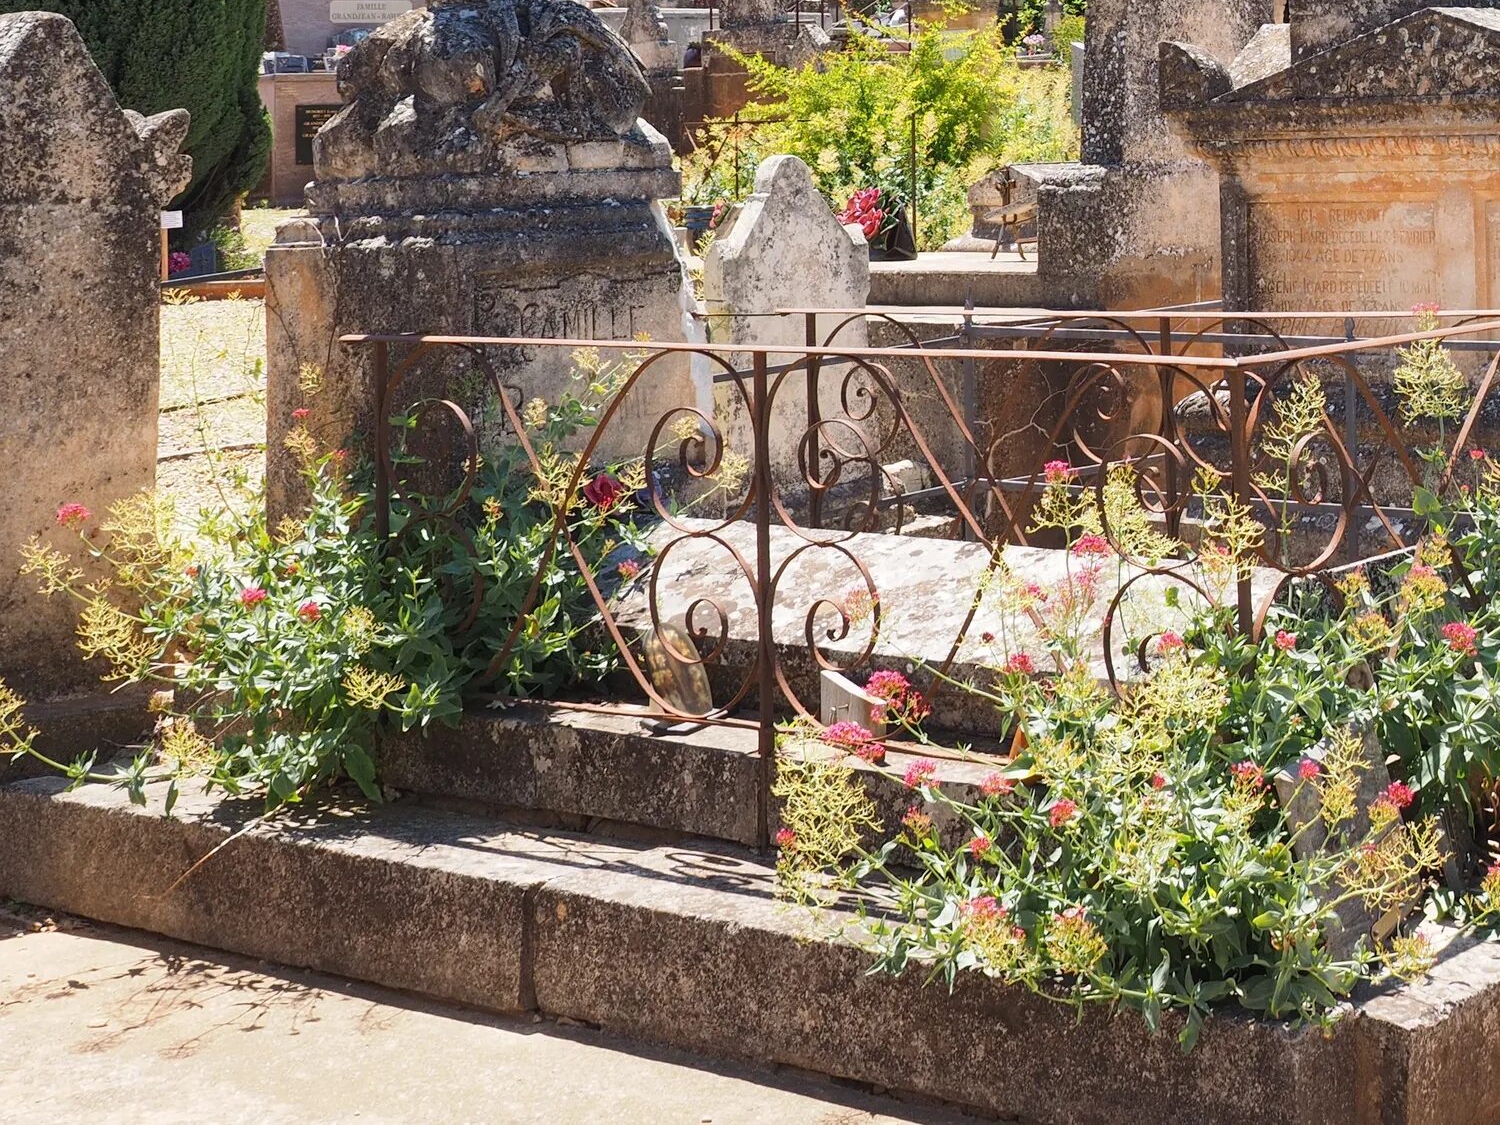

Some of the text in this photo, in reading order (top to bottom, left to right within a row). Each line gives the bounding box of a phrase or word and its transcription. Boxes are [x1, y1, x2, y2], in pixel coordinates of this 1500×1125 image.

[356, 3, 387, 11] FAMILLE
[1297, 209, 1313, 222] ICI
[1344, 249, 1358, 263] DE
[1377, 249, 1404, 264] ANS
[1303, 277, 1337, 294] ICARD
